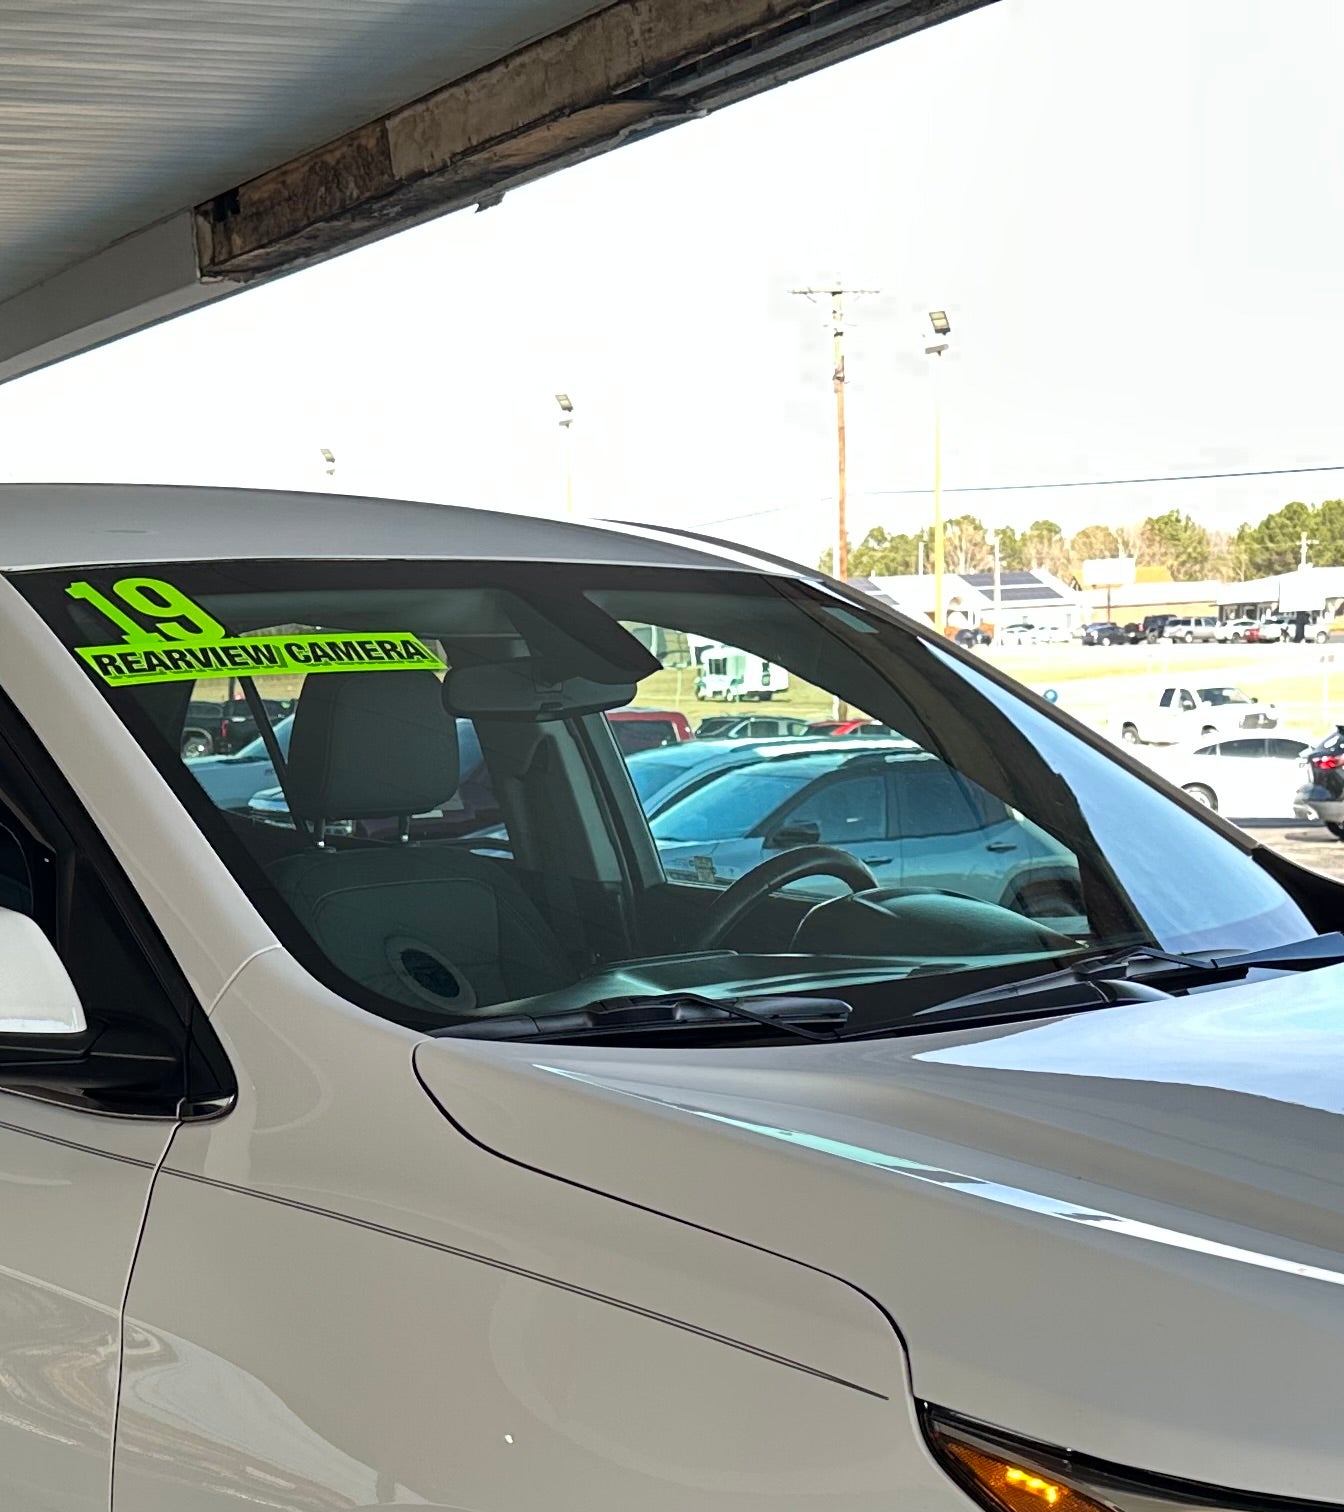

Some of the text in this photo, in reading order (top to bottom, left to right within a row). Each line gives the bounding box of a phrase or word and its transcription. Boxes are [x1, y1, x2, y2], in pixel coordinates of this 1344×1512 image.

[64, 577, 226, 645] 19
[91, 638, 431, 677] REARVIEW CAMERA
